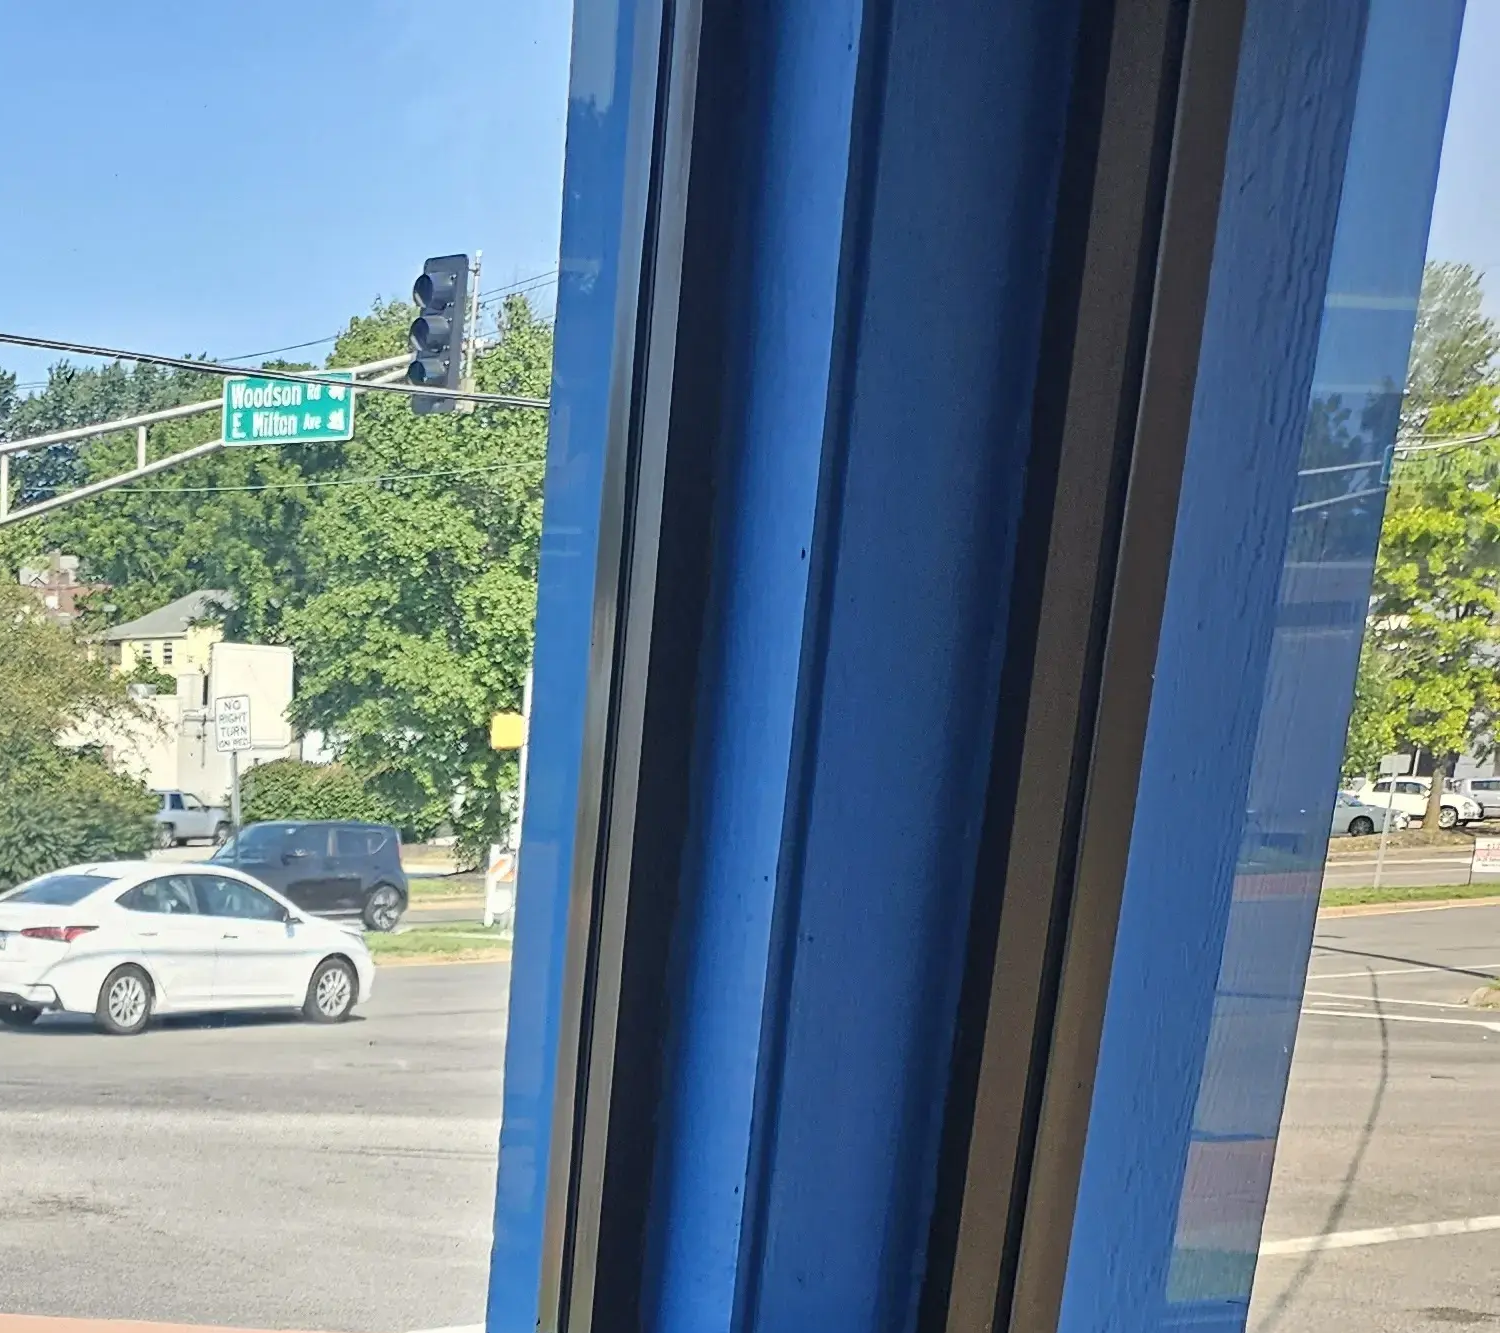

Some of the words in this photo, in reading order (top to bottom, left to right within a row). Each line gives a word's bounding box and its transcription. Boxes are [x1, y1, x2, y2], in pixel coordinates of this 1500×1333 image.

[231, 382, 302, 410] Woodson
[306, 383, 321, 400] Rd
[231, 412, 247, 439] E
[252, 411, 298, 438] Milton
[303, 412, 322, 430] Ave
[224, 700, 241, 711] NO
[220, 726, 247, 737] TURN
